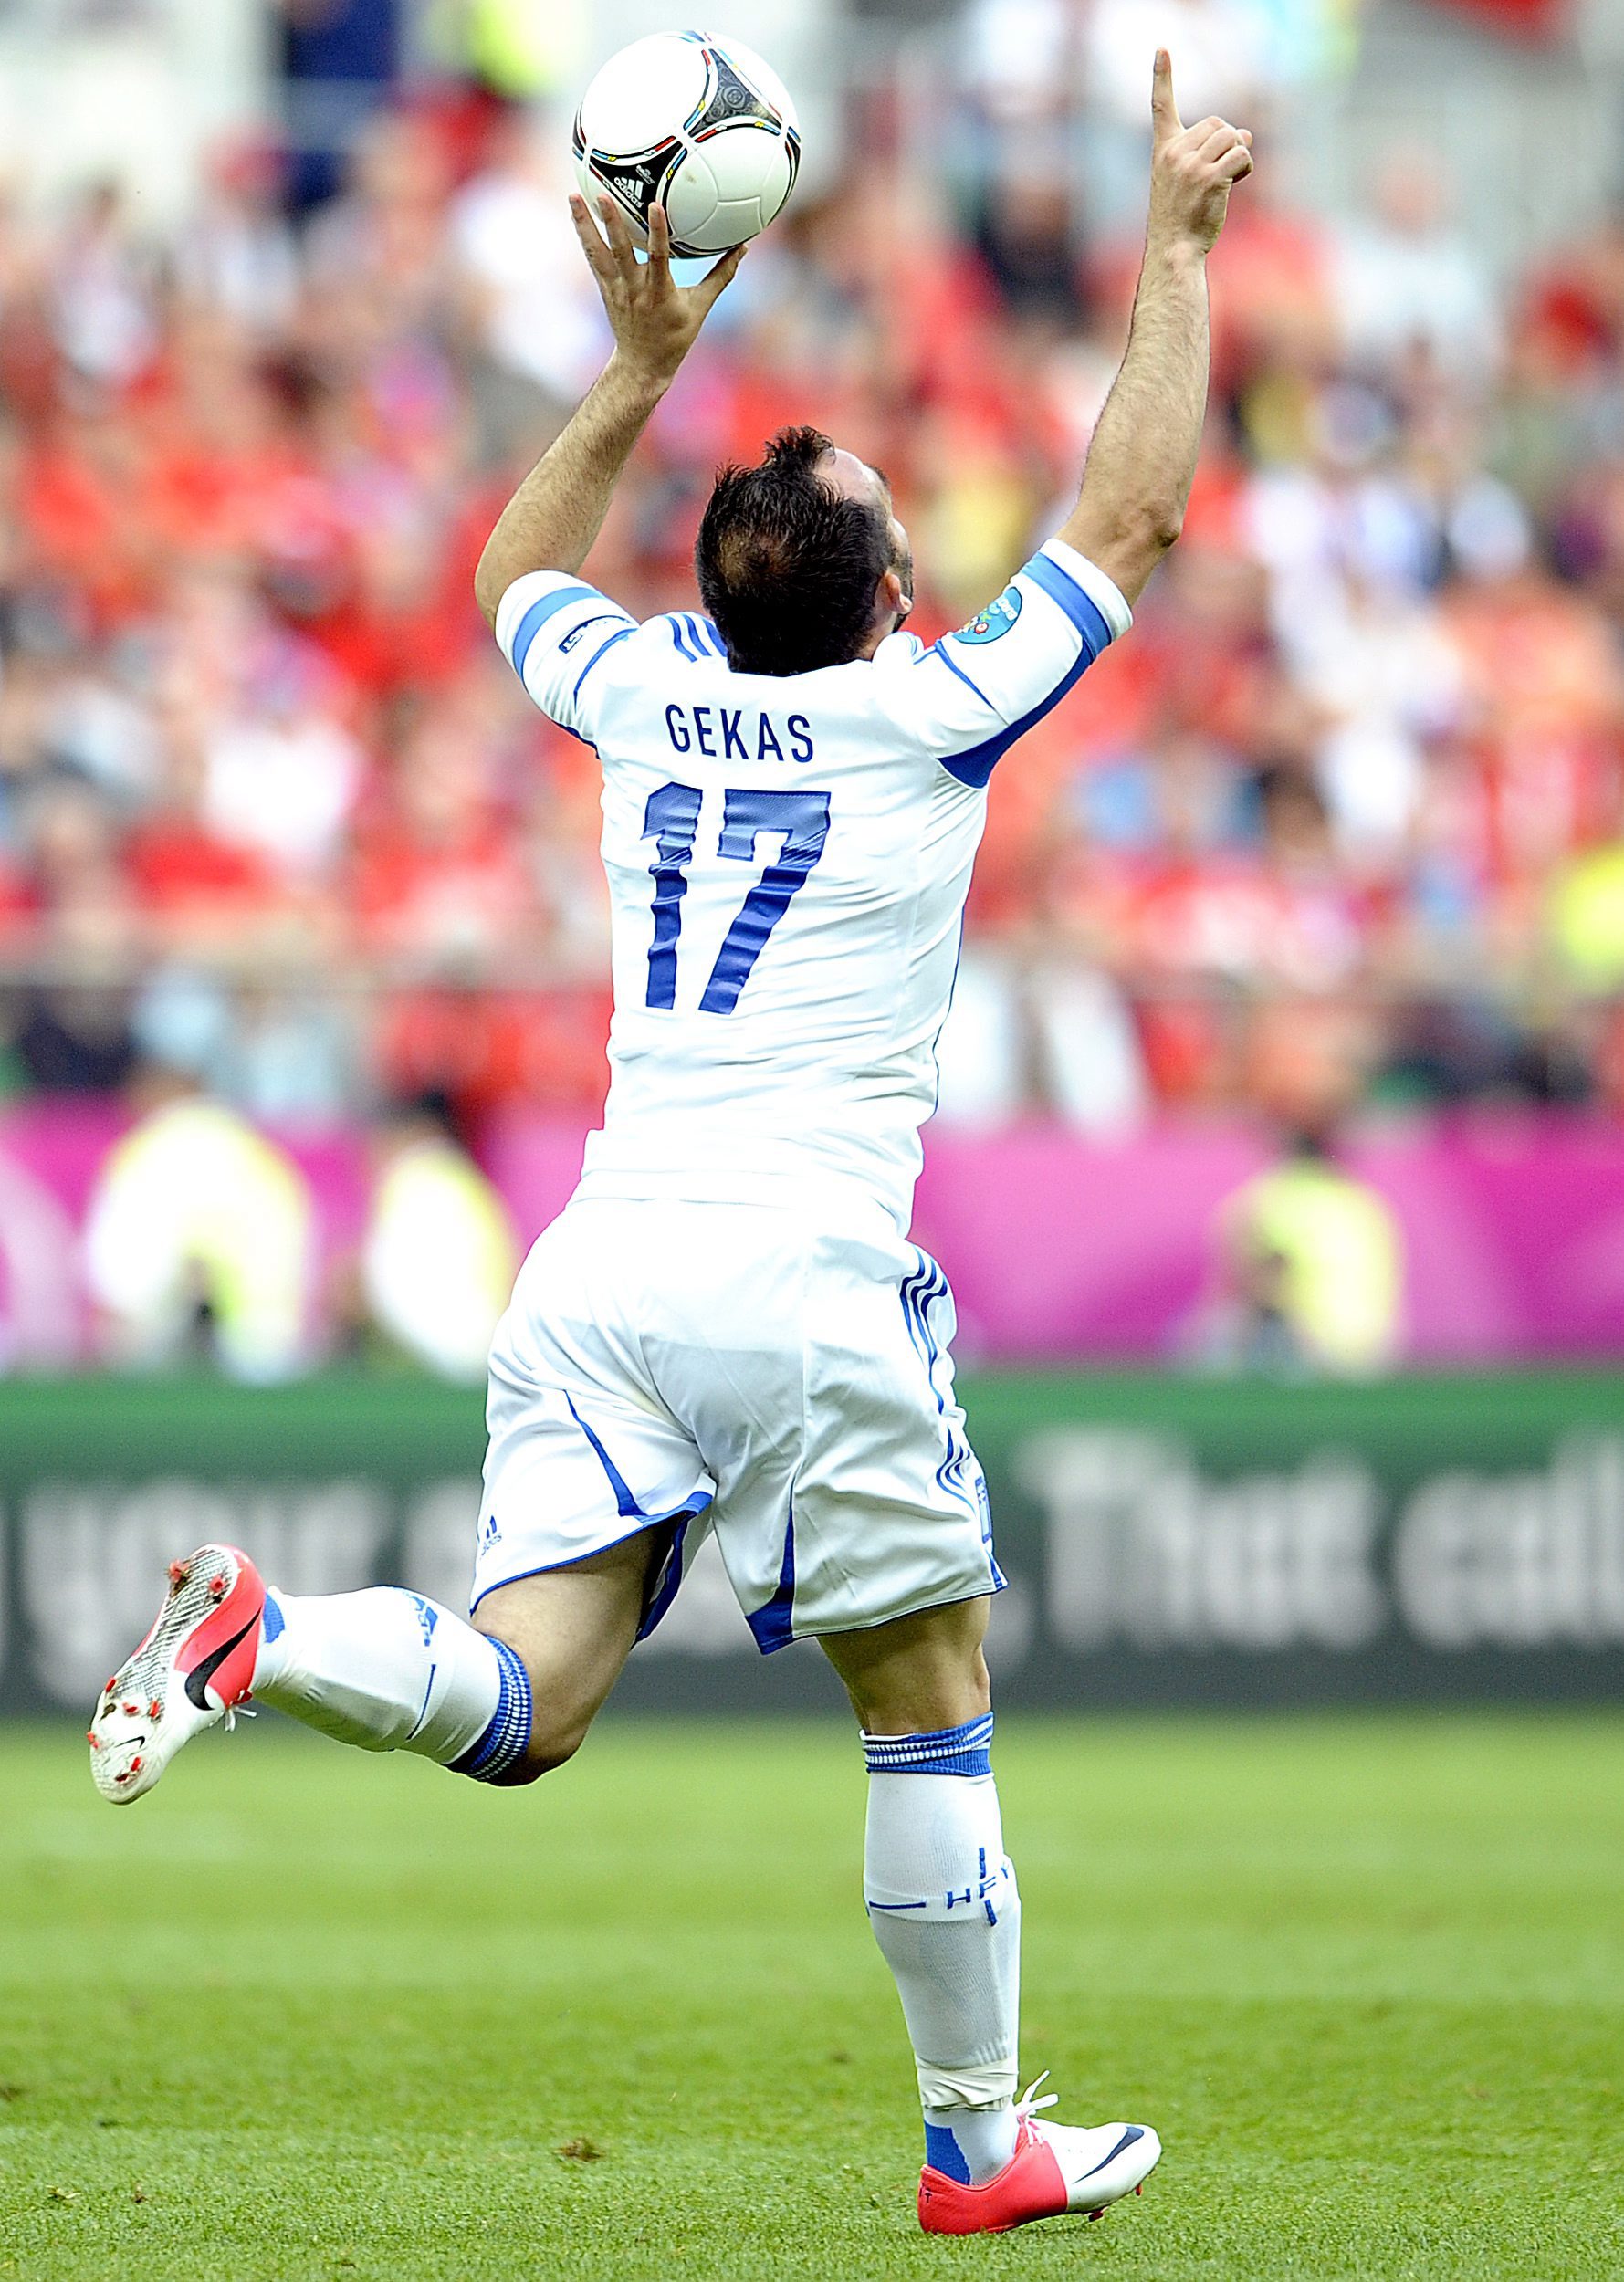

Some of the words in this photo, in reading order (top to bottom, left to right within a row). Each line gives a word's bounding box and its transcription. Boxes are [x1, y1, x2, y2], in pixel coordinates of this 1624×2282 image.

[613, 176, 644, 208] adidas
[665, 704, 814, 763] GEKAS
[640, 781, 832, 1015] 17
